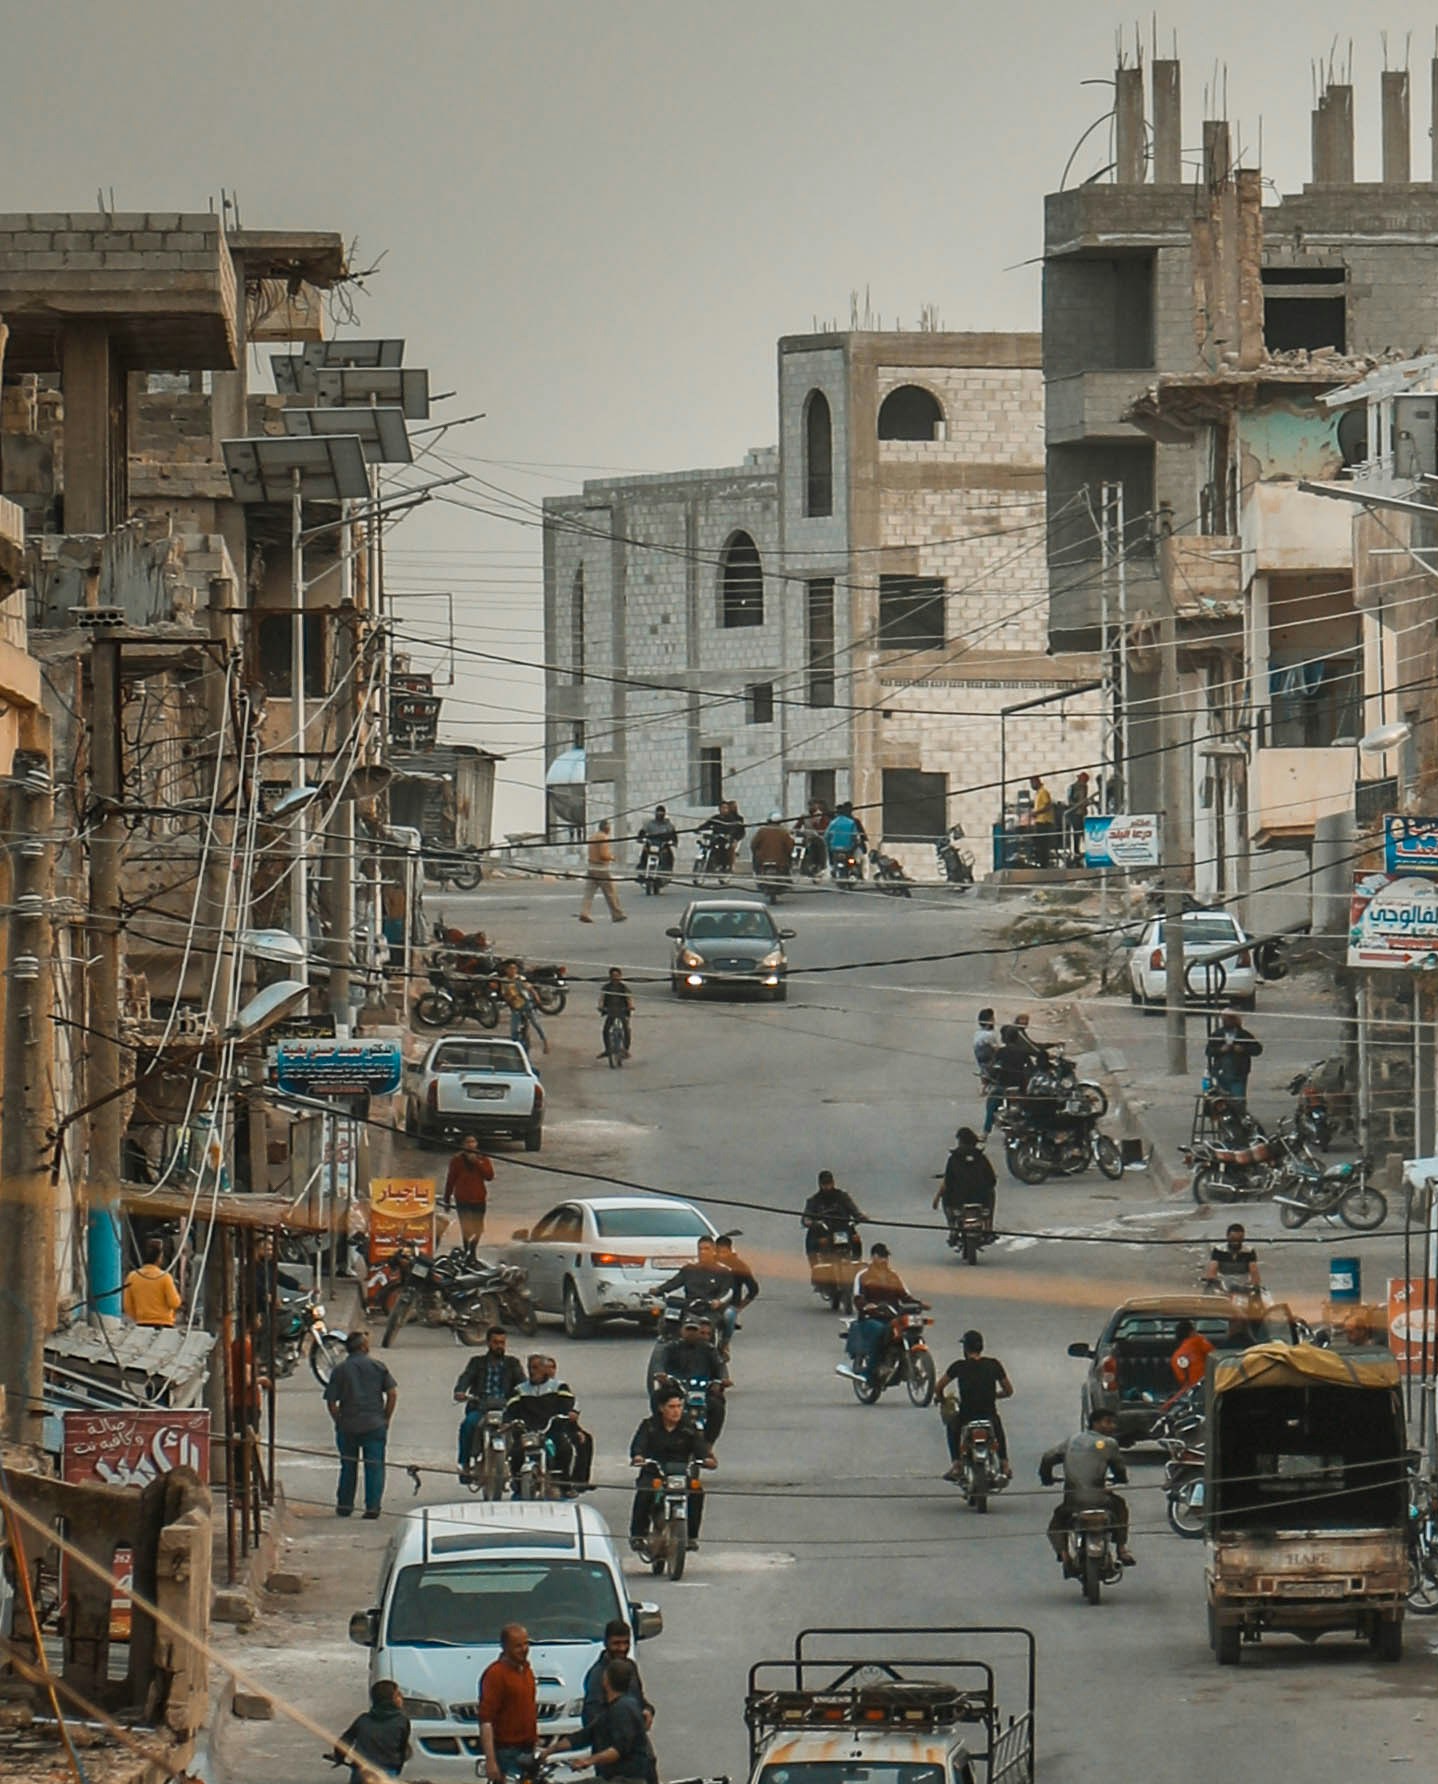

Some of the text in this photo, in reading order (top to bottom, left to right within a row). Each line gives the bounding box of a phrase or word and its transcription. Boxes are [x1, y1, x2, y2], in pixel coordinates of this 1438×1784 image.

[337, 1046, 363, 1057] محمد
[364, 1042, 396, 1059] الدكتور
[86, 1416, 126, 1436] صالة
[73, 1442, 96, 1455] نت
